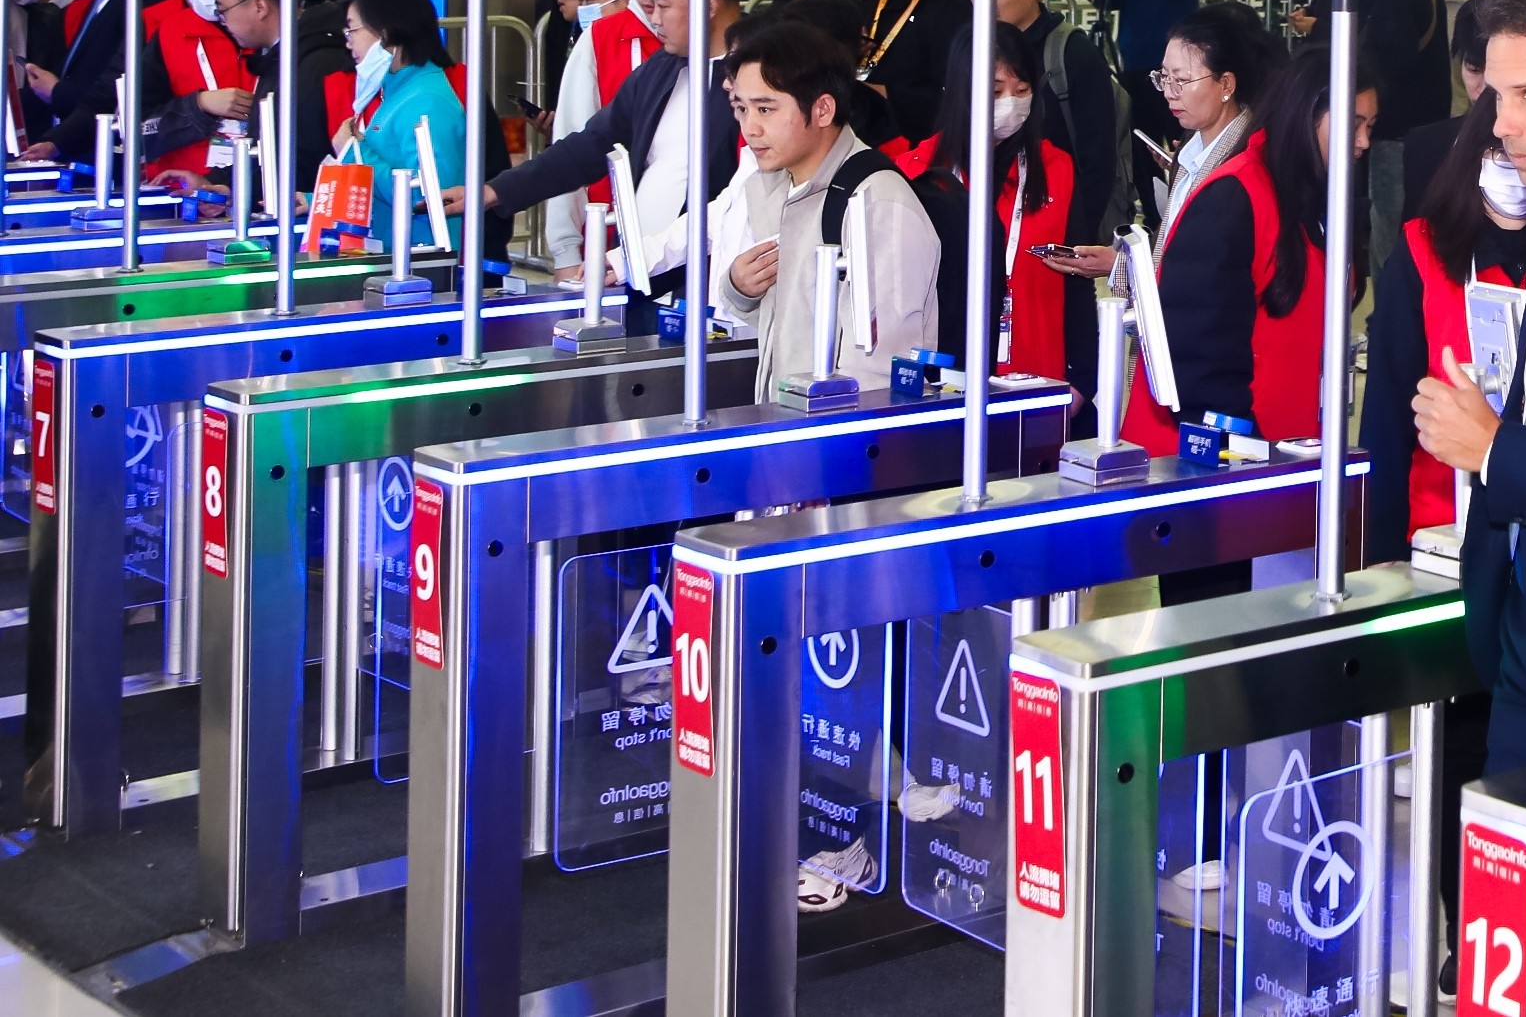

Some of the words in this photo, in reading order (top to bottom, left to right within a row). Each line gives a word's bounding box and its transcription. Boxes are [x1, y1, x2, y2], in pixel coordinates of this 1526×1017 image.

[35, 410, 51, 458] 7
[205, 465, 222, 518] 8
[415, 543, 435, 602] 9
[675, 632, 710, 703] 10
[1015, 749, 1054, 832] 11
[1465, 916, 1524, 1017] 12
